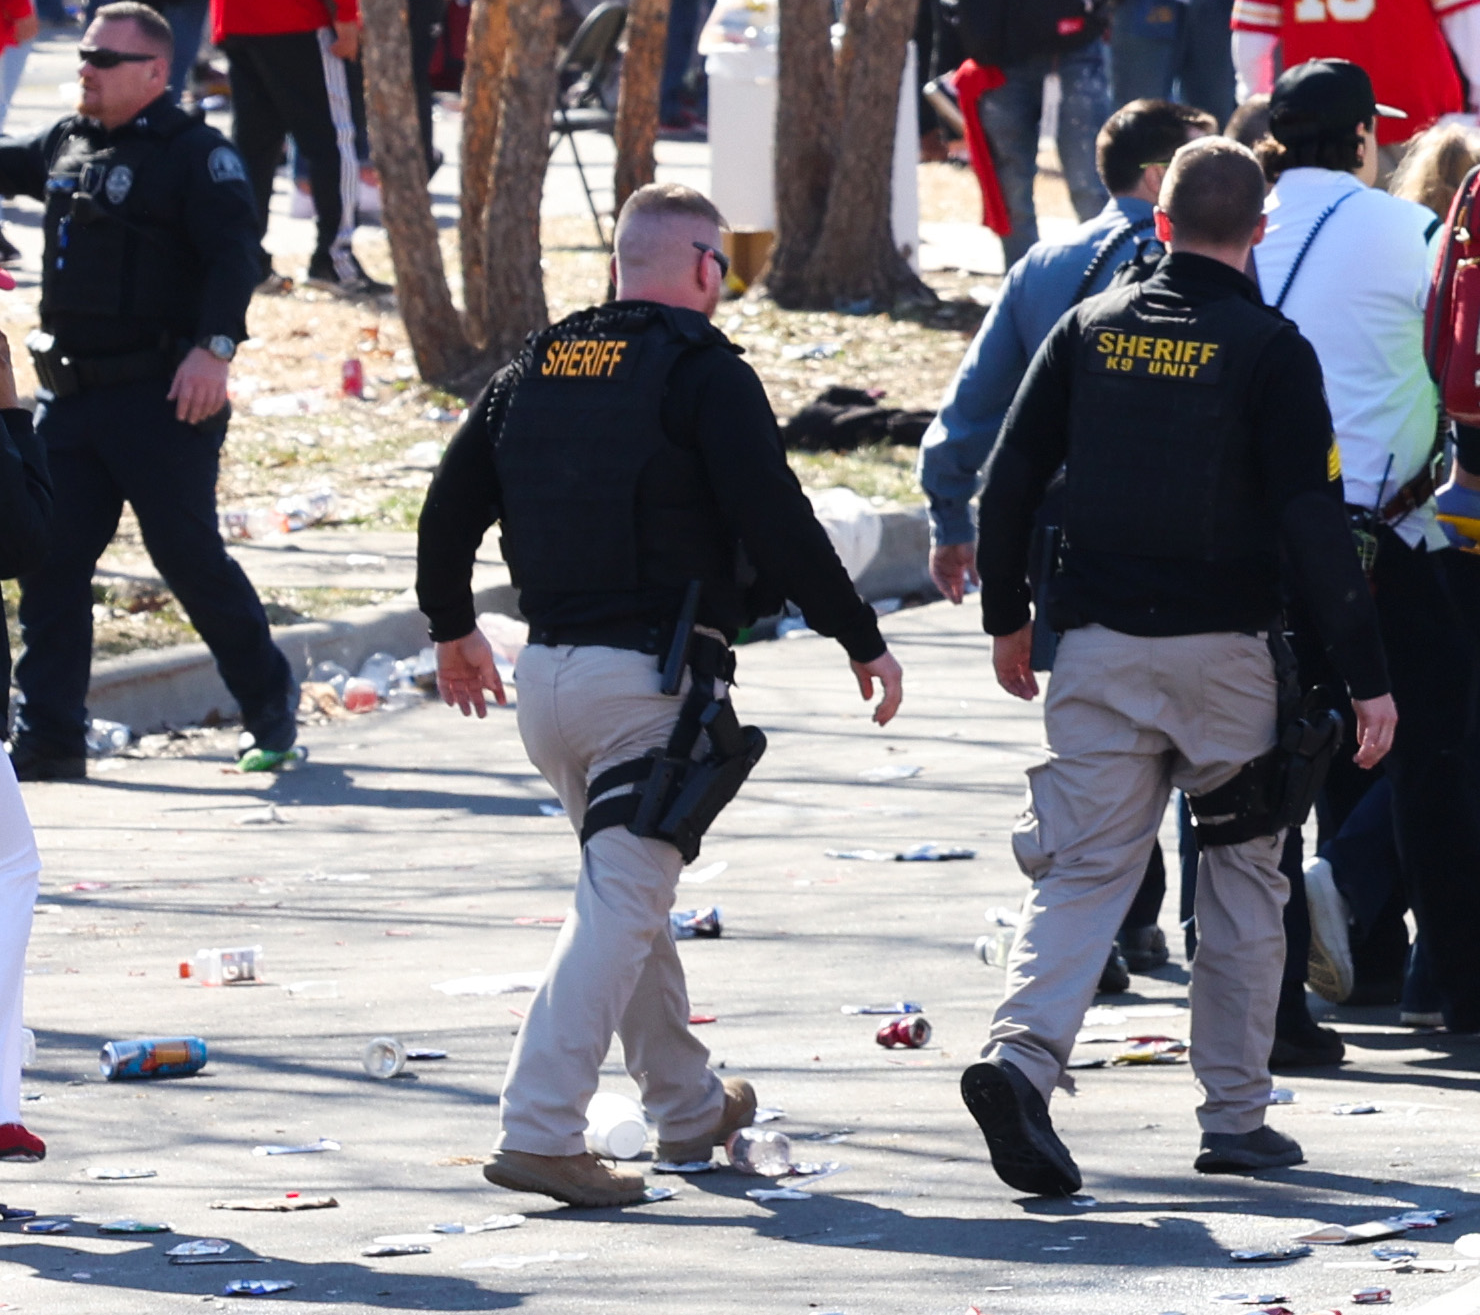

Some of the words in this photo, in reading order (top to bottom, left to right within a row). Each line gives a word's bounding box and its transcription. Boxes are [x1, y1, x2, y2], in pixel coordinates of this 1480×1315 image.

[541, 340, 628, 377] SHERIFF
[1095, 330, 1220, 365] SHERIFF
[1105, 357, 1134, 374] K9
[1147, 361, 1200, 380] UNIT
